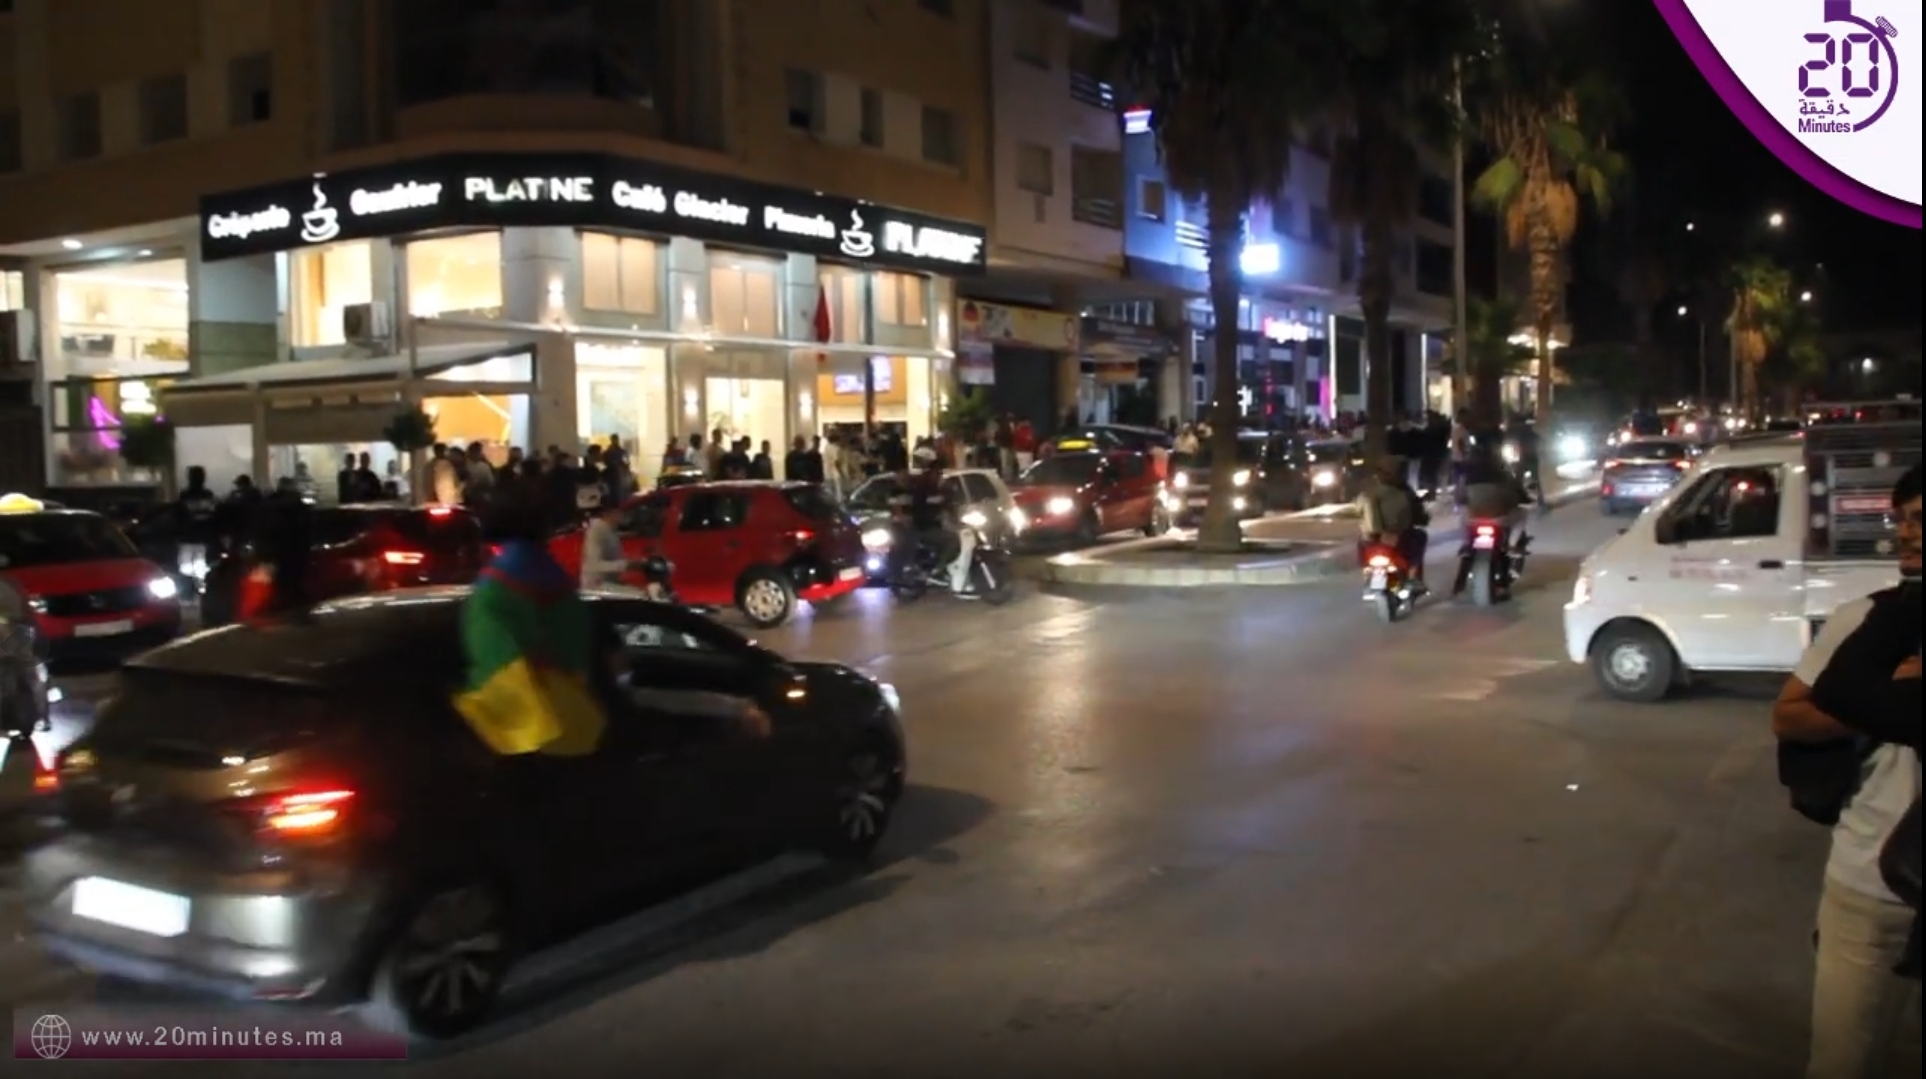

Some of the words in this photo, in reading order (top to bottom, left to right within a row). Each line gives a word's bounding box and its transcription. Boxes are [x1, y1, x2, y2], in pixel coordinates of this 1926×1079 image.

[465, 176, 594, 203] PLATINE
[611, 181, 667, 213] Café
[673, 191, 751, 226] Glacier
